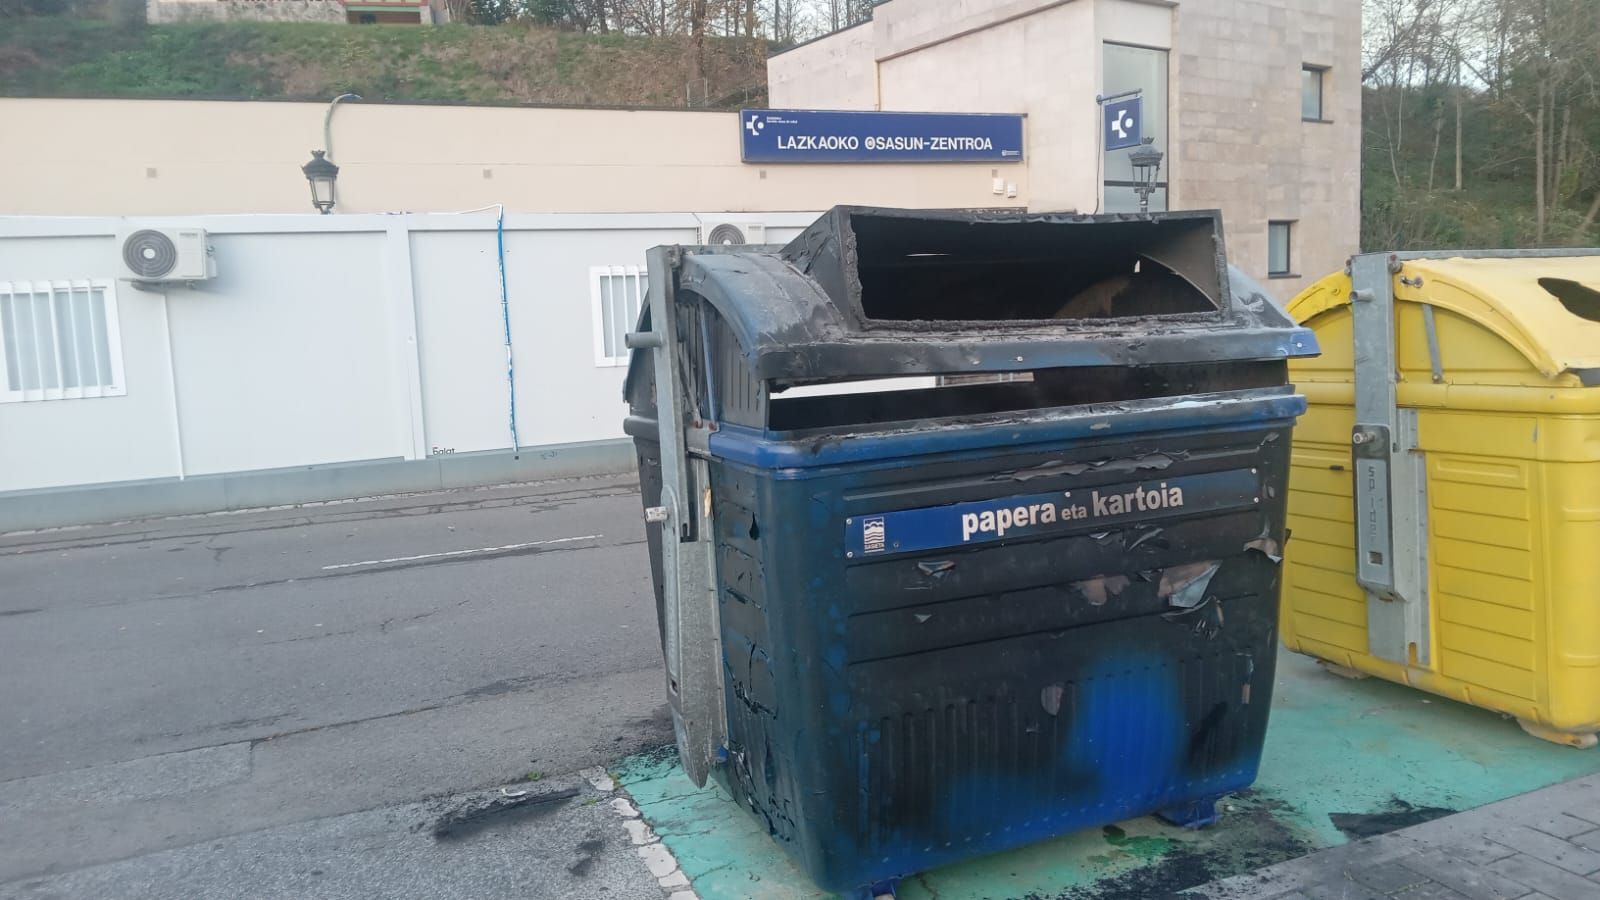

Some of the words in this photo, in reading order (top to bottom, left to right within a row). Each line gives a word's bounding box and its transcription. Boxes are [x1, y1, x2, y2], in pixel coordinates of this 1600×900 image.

[777, 136, 859, 150] LAZKAOKO
[864, 136, 993, 151] OSASUN-ZENTROA
[962, 502, 1057, 541] papera
[1061, 504, 1088, 521] eta
[1092, 482, 1184, 517] kartoia
